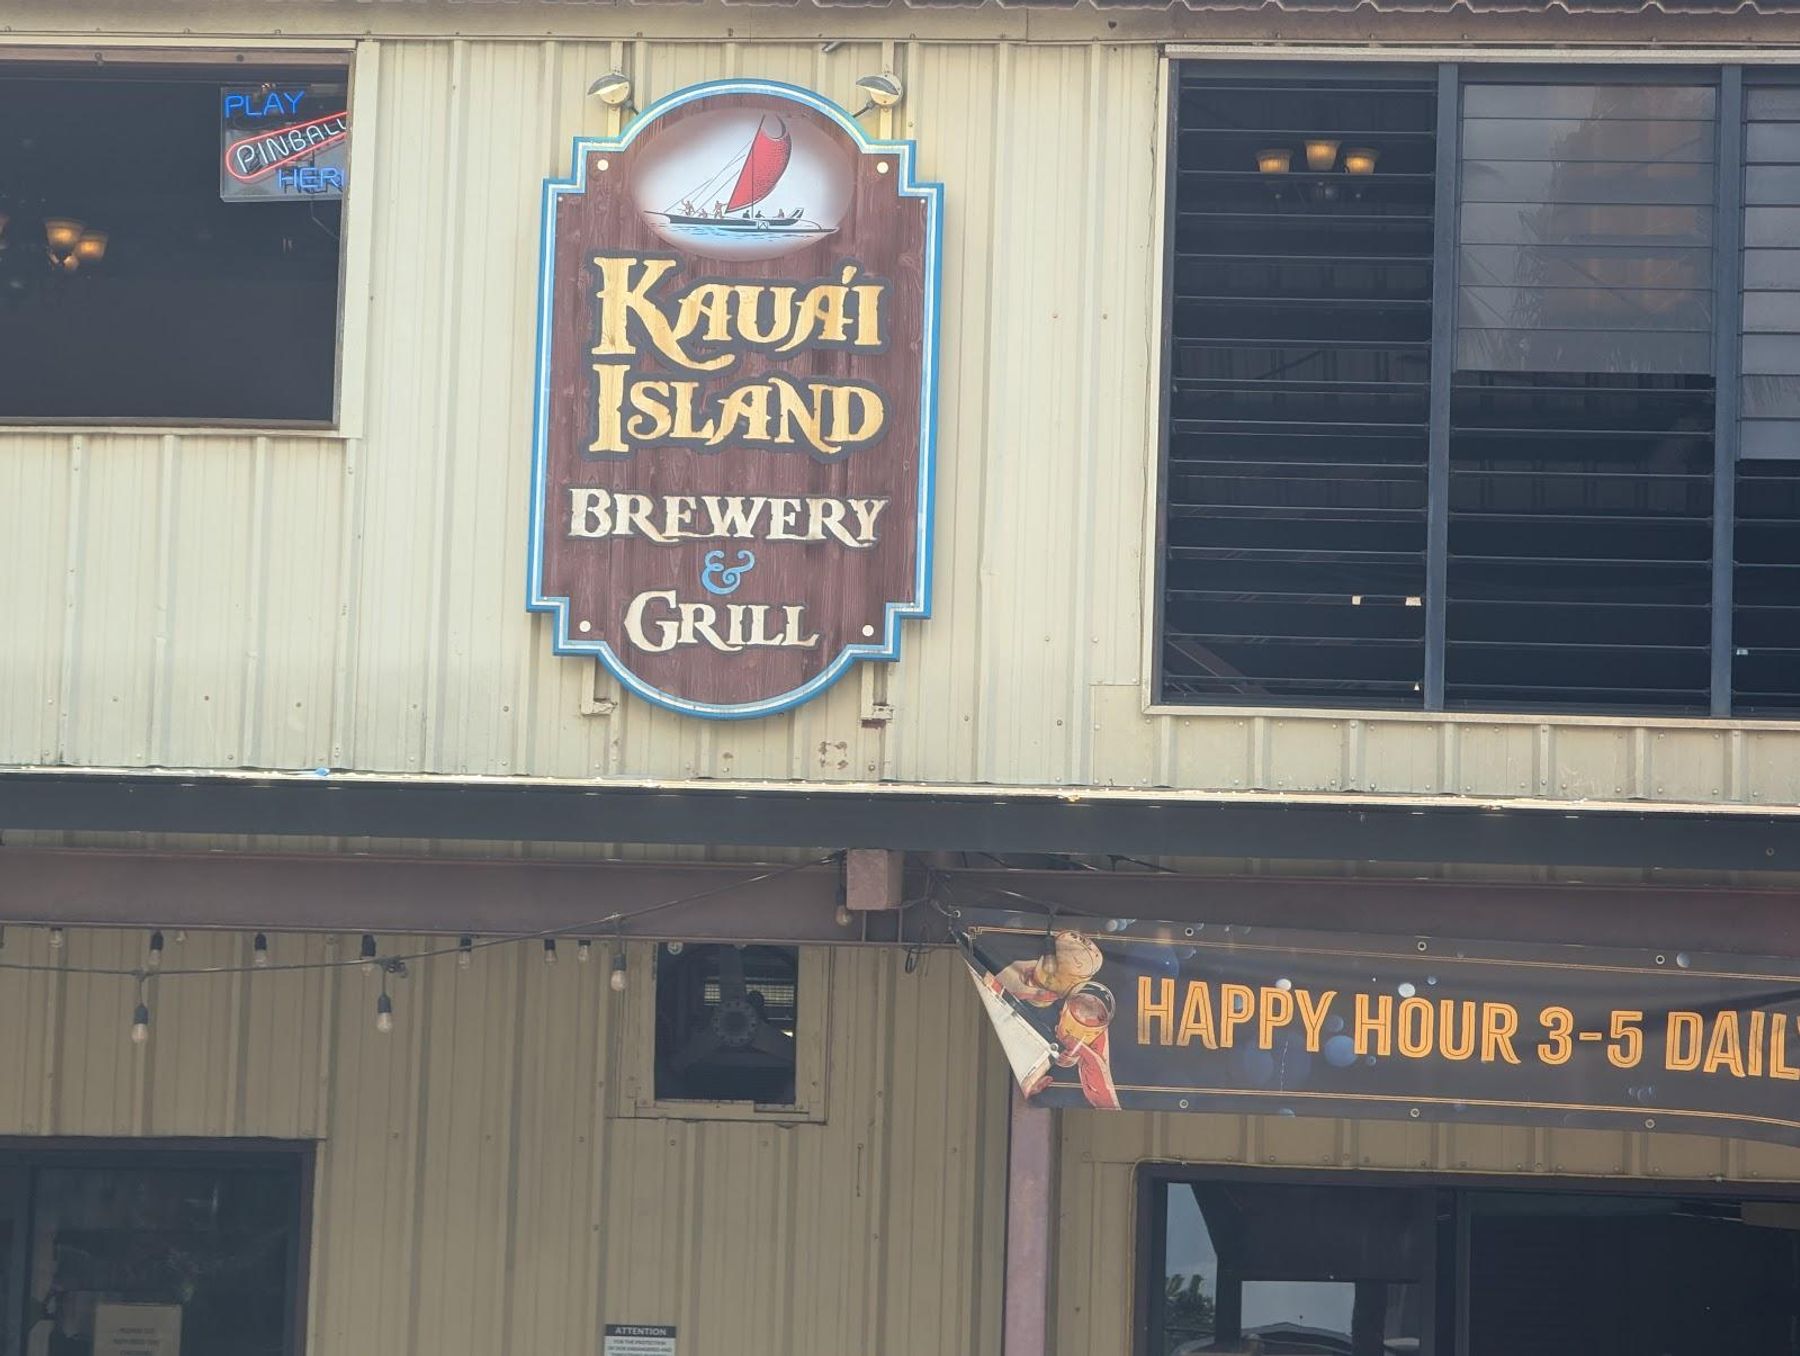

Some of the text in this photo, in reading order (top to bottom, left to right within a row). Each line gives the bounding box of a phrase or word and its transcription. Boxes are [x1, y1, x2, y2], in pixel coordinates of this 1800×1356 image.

[224, 91, 305, 119] PLAY
[278, 167, 345, 190] HER
[588, 364, 886, 455] ISLAND
[568, 488, 888, 547] BREWERY
[701, 550, 756, 596] &
[624, 590, 821, 654] GRILL
[1136, 975, 1800, 1081] HAPPY HOUR 3-5 DAIL
[615, 1327, 667, 1335] ATTENTION
